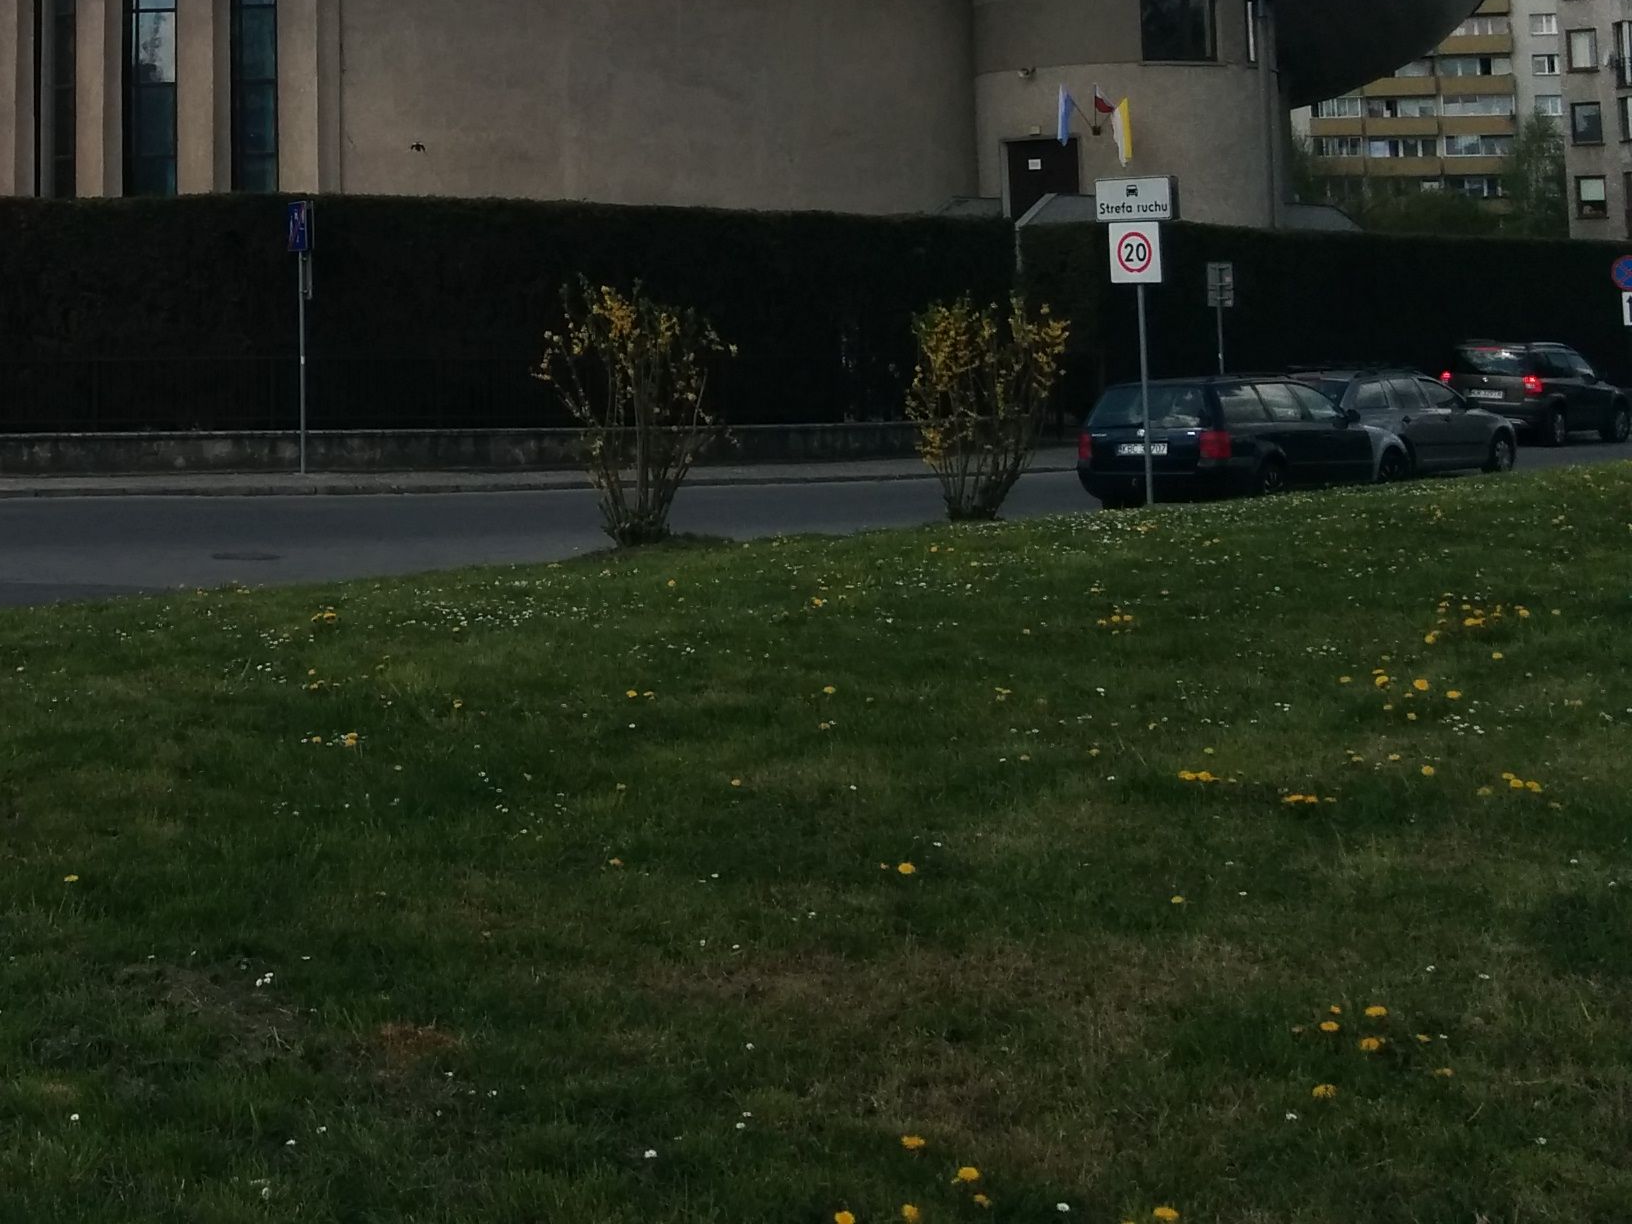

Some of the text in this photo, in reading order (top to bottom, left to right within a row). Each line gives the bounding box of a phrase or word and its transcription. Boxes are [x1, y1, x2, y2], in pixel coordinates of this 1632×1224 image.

[1099, 201, 1168, 214] Strefa ruchu
[1124, 242, 1147, 263] 20
